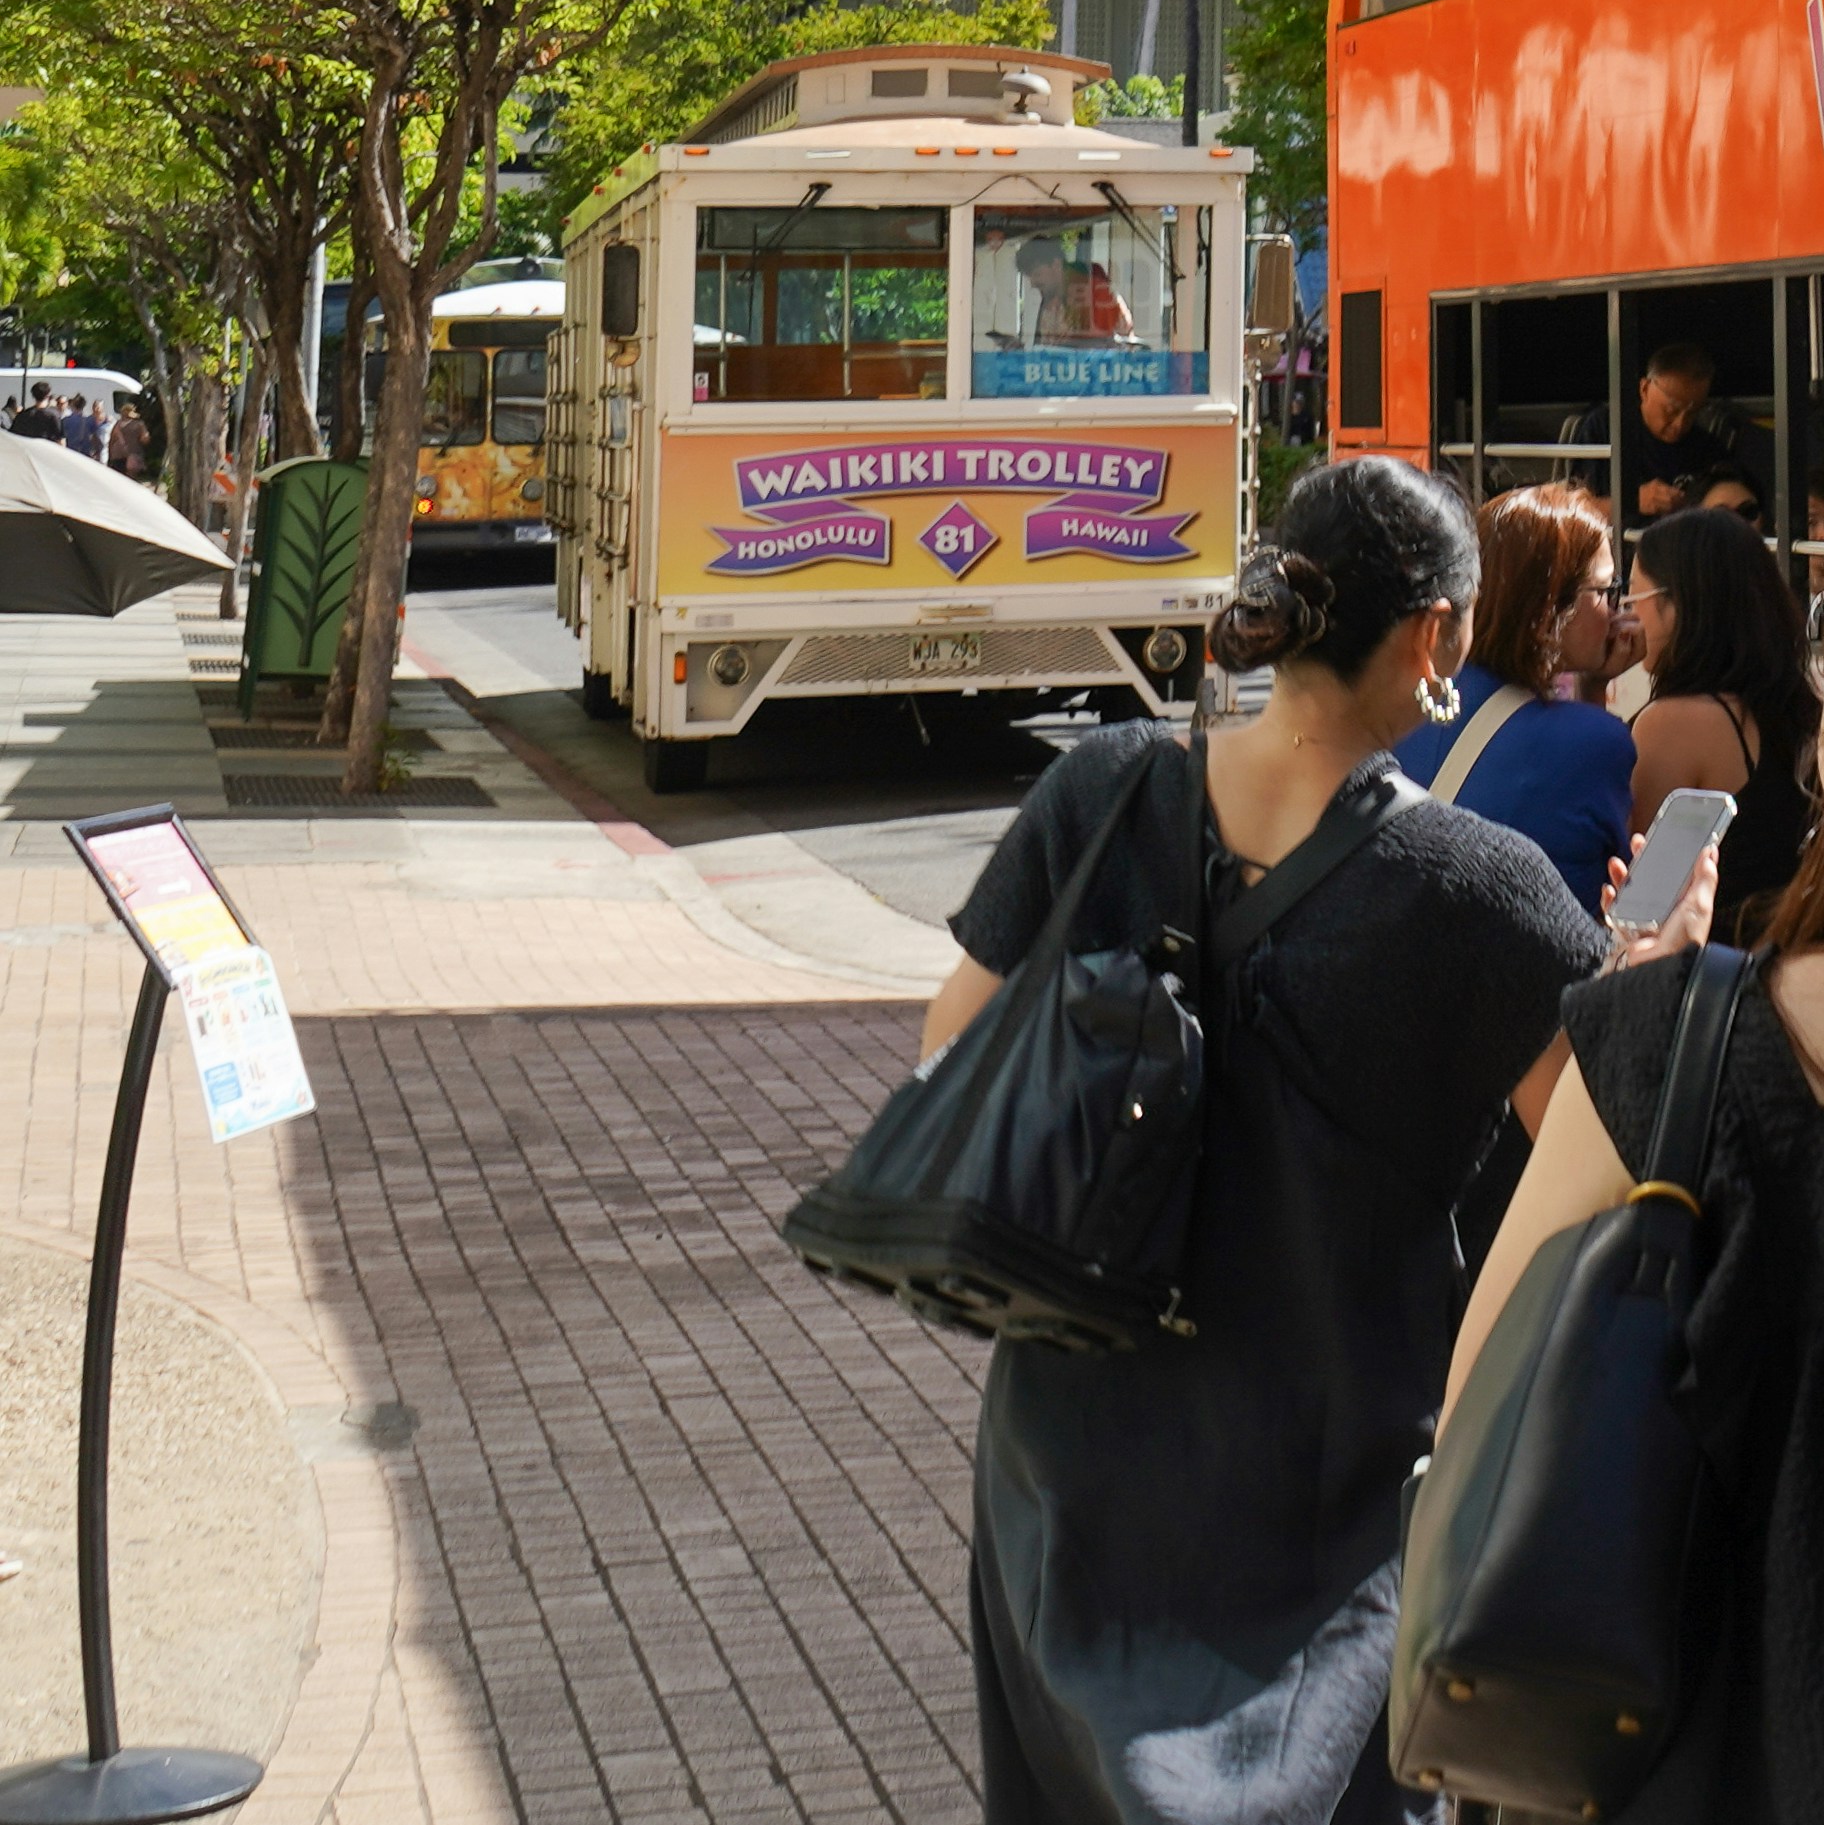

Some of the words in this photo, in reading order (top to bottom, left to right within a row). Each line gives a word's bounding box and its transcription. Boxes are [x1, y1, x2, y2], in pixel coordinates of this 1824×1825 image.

[1024, 361, 1091, 384] BLUE
[1099, 359, 1160, 383] LINE
[747, 450, 946, 501] WAIKIKI
[956, 448, 1155, 490] TROLLEY
[737, 526, 878, 560] HONOLULU
[934, 523, 976, 556] 81
[1061, 517, 1151, 549] HAWAII
[1204, 593, 1224, 608] 81
[913, 640, 940, 661] WJA
